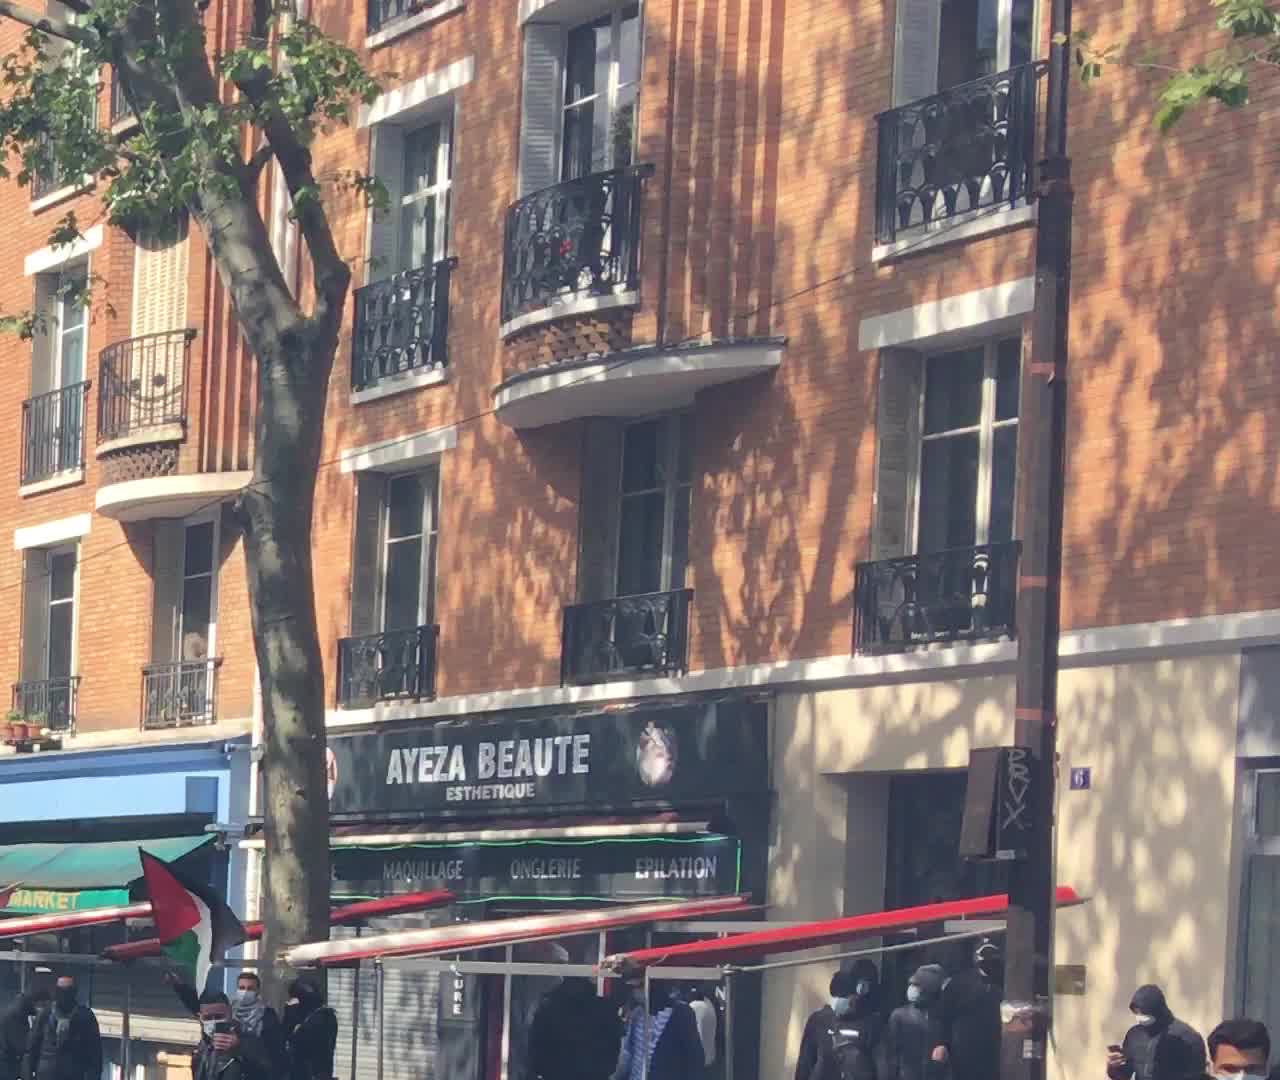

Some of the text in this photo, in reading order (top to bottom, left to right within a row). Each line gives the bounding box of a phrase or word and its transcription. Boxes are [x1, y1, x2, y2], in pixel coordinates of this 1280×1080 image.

[386, 734, 591, 785] AYEZA BEAUTE
[445, 782, 536, 801] ESTHETIQUE
[383, 856, 718, 881] MAQUILLAGE ONGLERIE EPILATION
